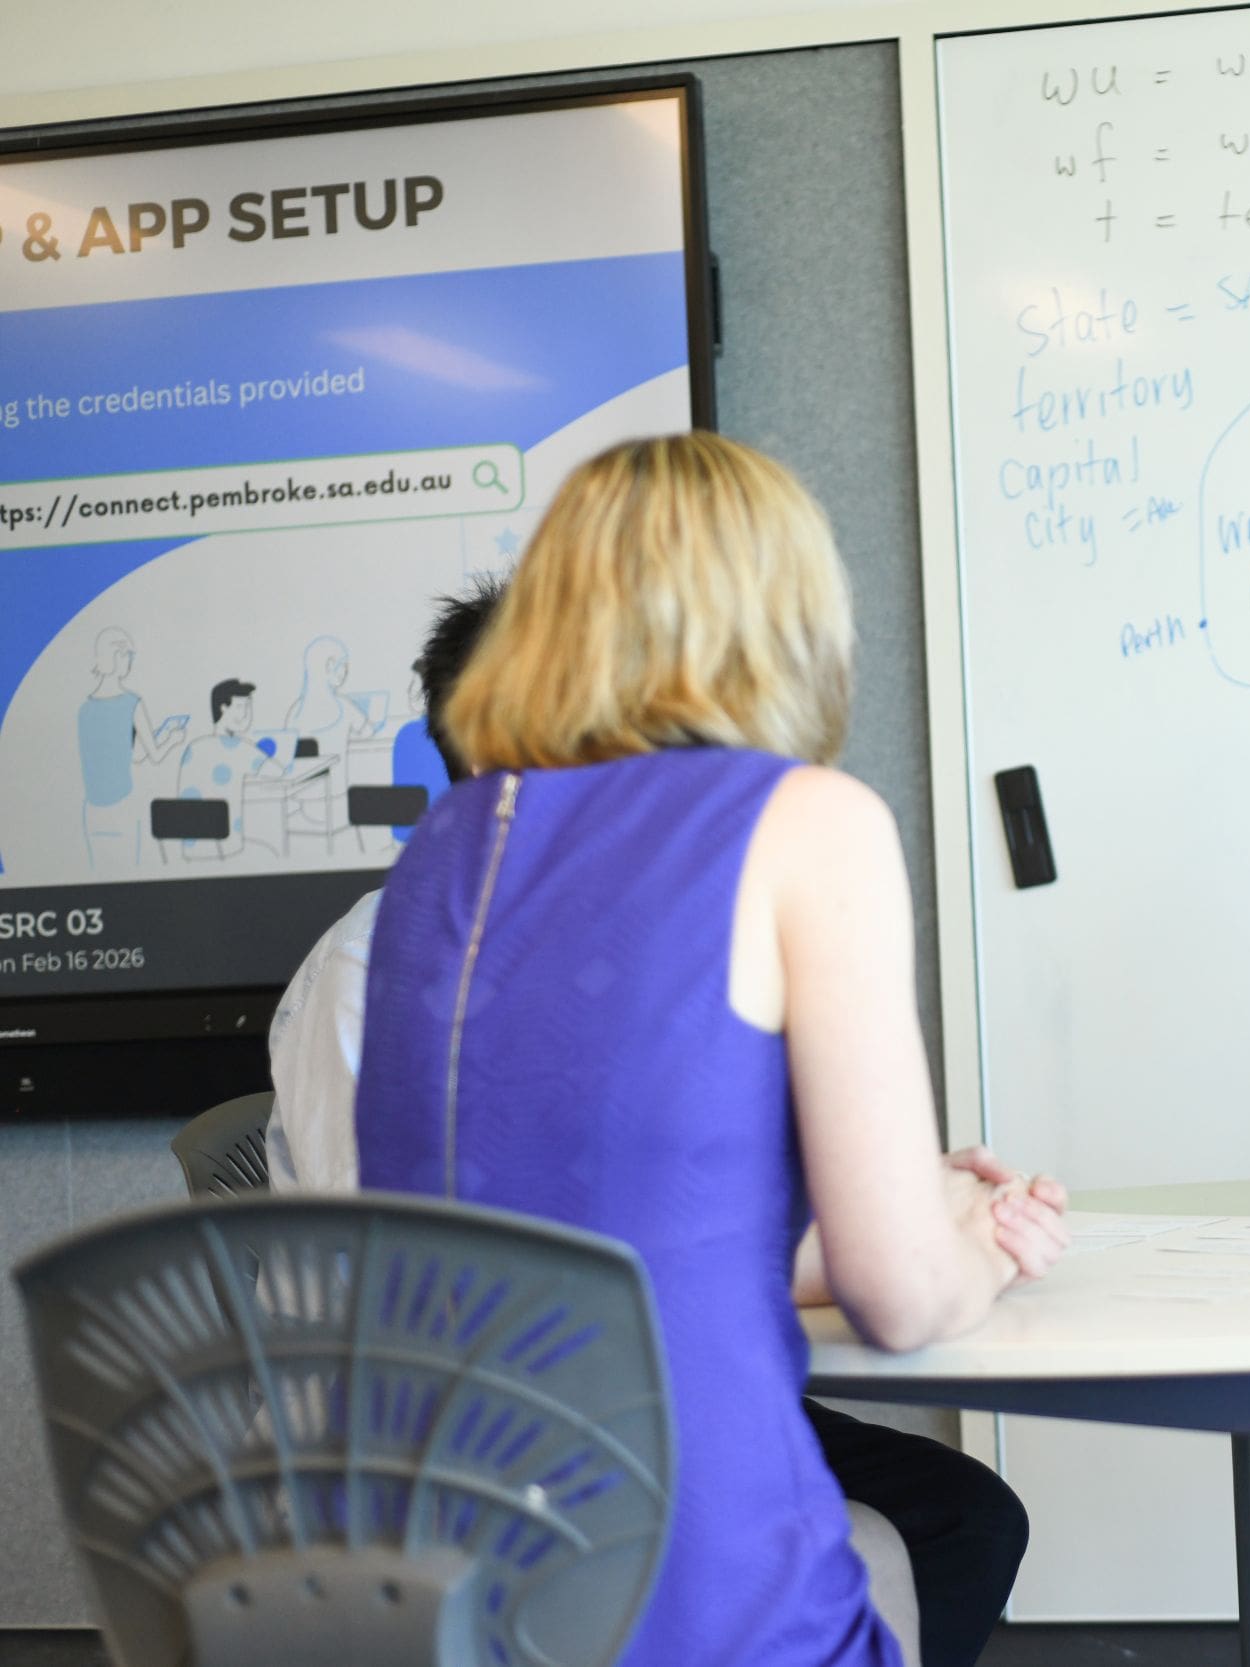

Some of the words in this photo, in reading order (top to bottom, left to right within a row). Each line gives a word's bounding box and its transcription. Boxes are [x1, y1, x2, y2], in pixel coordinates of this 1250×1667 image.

[22, 211, 62, 263] &
[77, 197, 211, 259] APP
[228, 175, 445, 244] SETUP
[26, 393, 71, 420] the
[77, 378, 233, 416] credentials
[239, 366, 367, 408] provided
[1119, 613, 1187, 659] Perth
[0, 910, 58, 939] SRC
[66, 907, 104, 936] 03
[22, 950, 62, 973] Feb
[65, 950, 88, 971] 16
[91, 947, 146, 970] 2026
